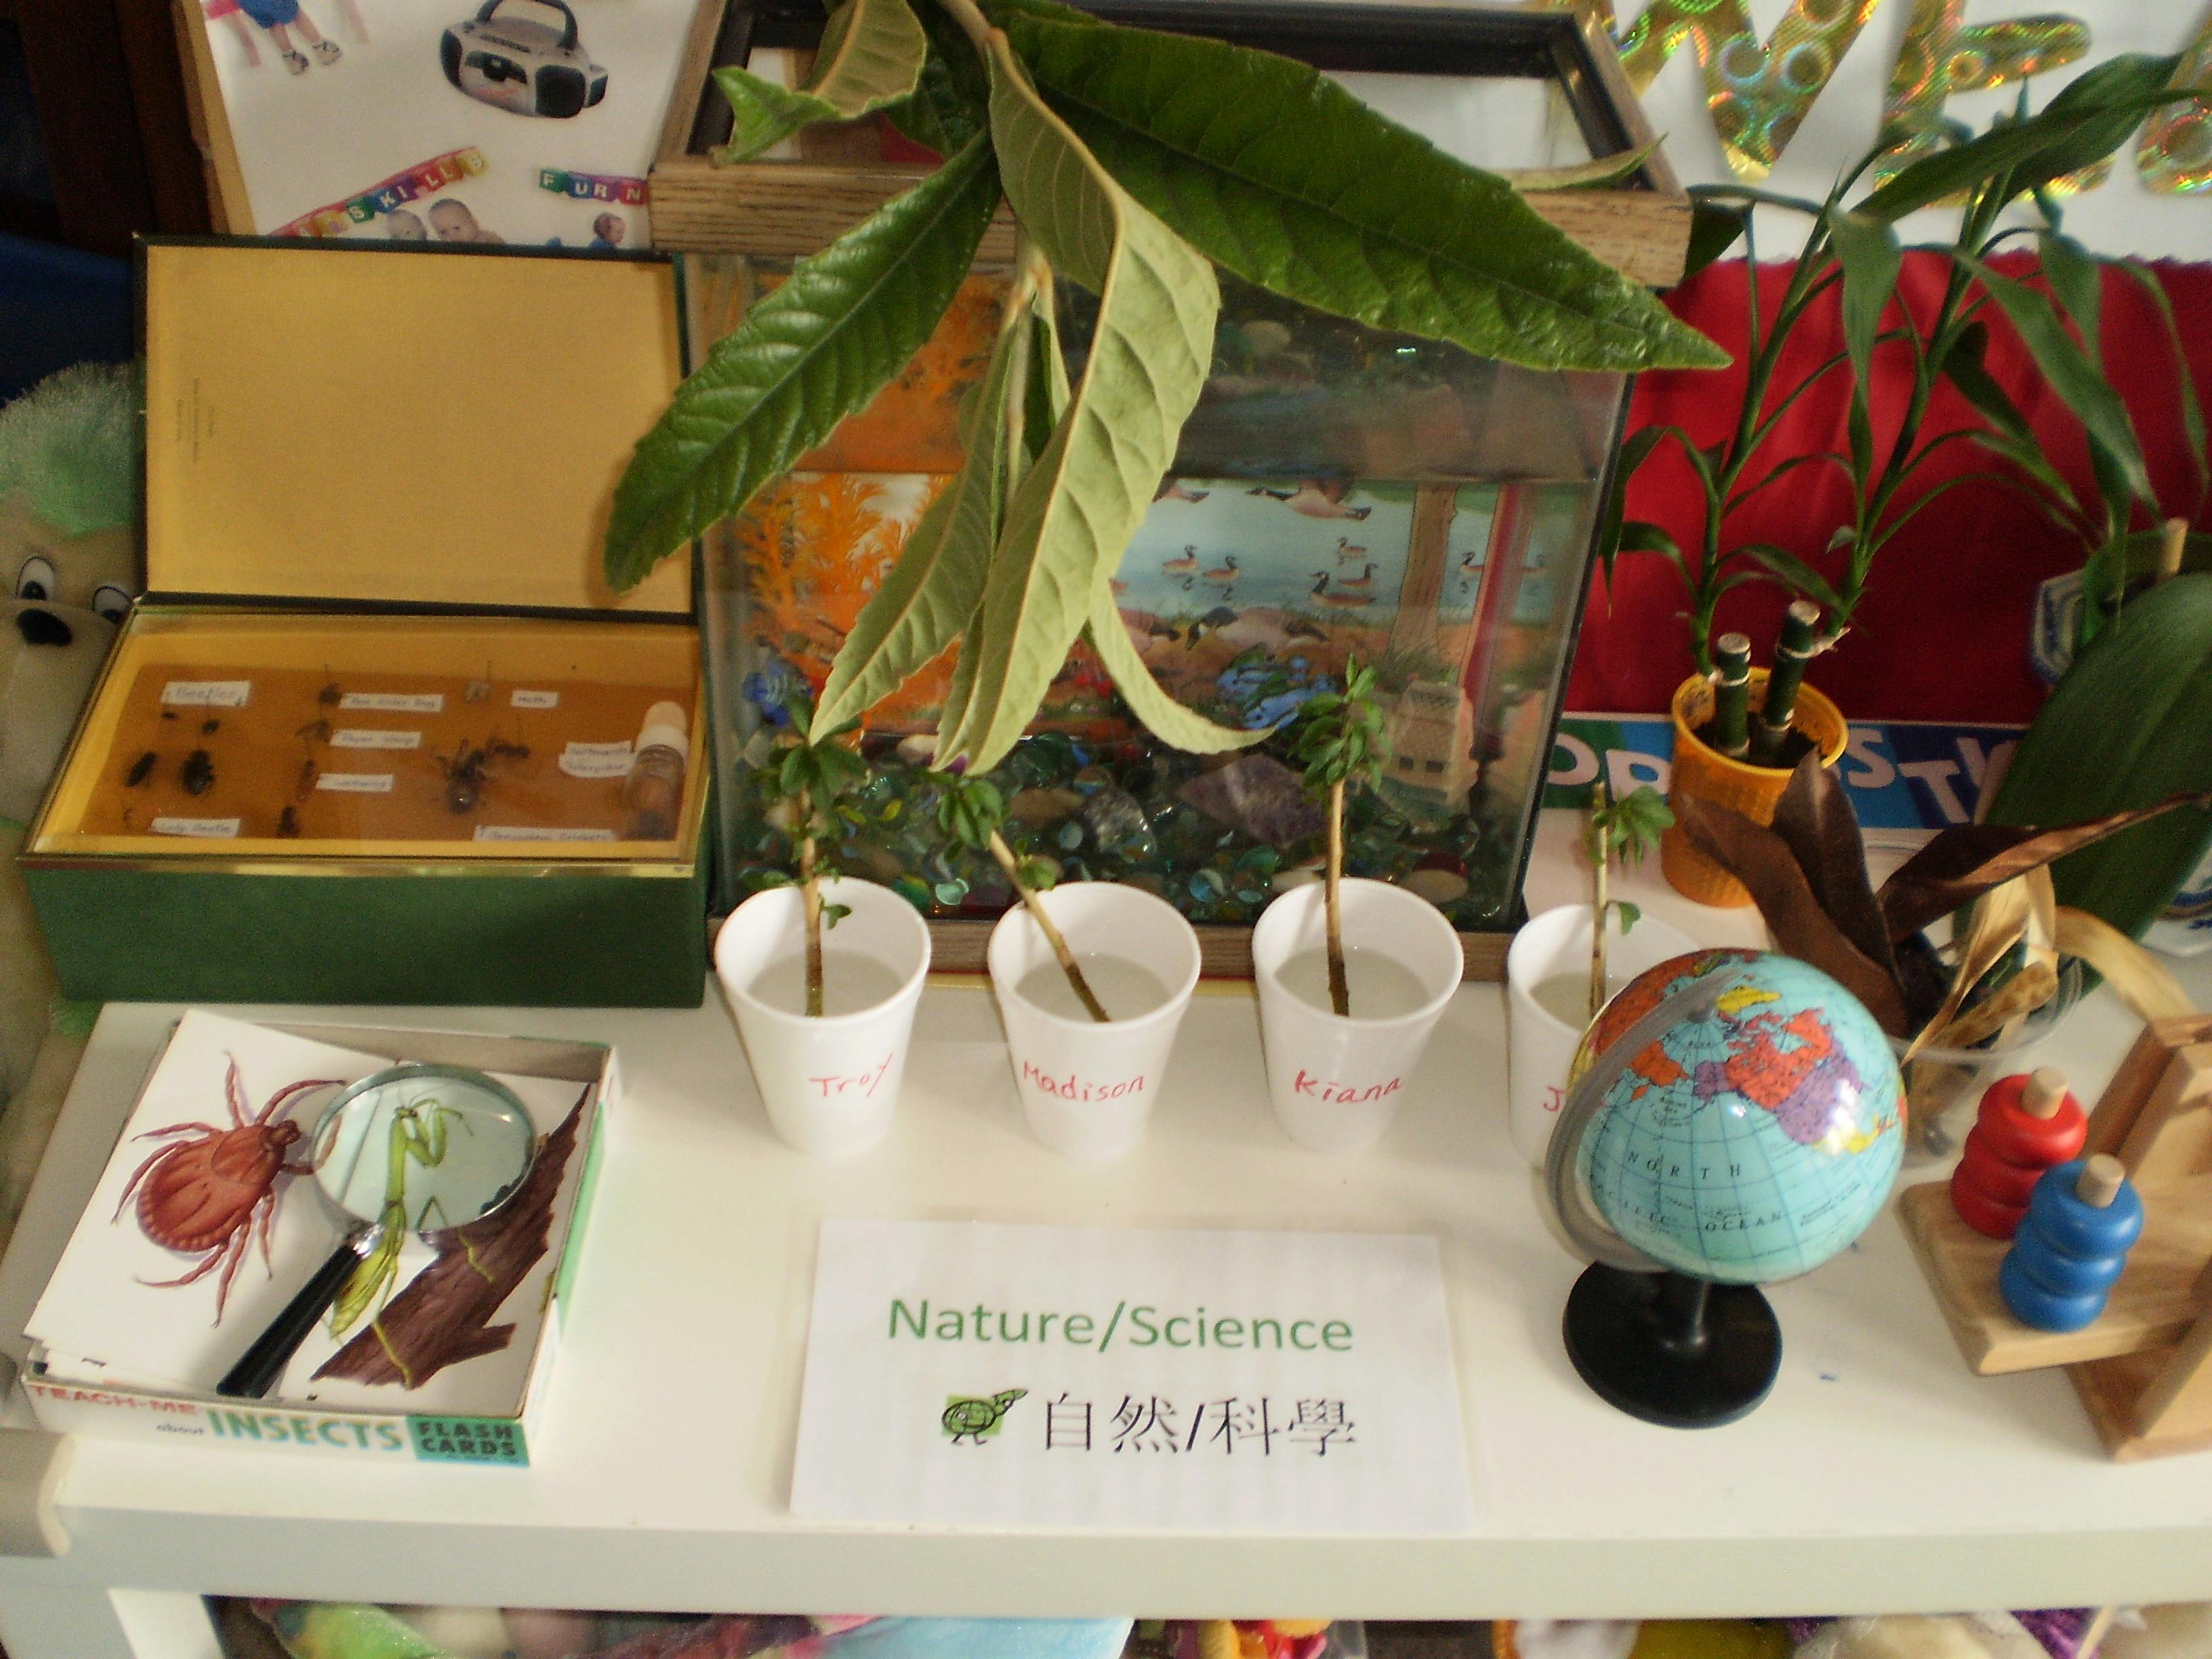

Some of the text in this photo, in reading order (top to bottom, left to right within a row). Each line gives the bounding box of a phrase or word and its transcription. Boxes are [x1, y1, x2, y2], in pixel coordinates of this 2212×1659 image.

[1023, 1061, 1145, 1103] Madison
[1294, 1069, 1401, 1103] Kiana
[1627, 1151, 1741, 1179] NORTH
[1705, 1210, 1782, 1232] OCEAN
[888, 1298, 1355, 1355] Nature/Science
[27, 1384, 199, 1416] TEACH-ME
[156, 1406, 405, 1452] about INSECTS
[417, 1421, 513, 1439] FLASH
[1045, 1391, 1357, 1457] 自然/科學
[421, 1437, 516, 1456] CARDS
